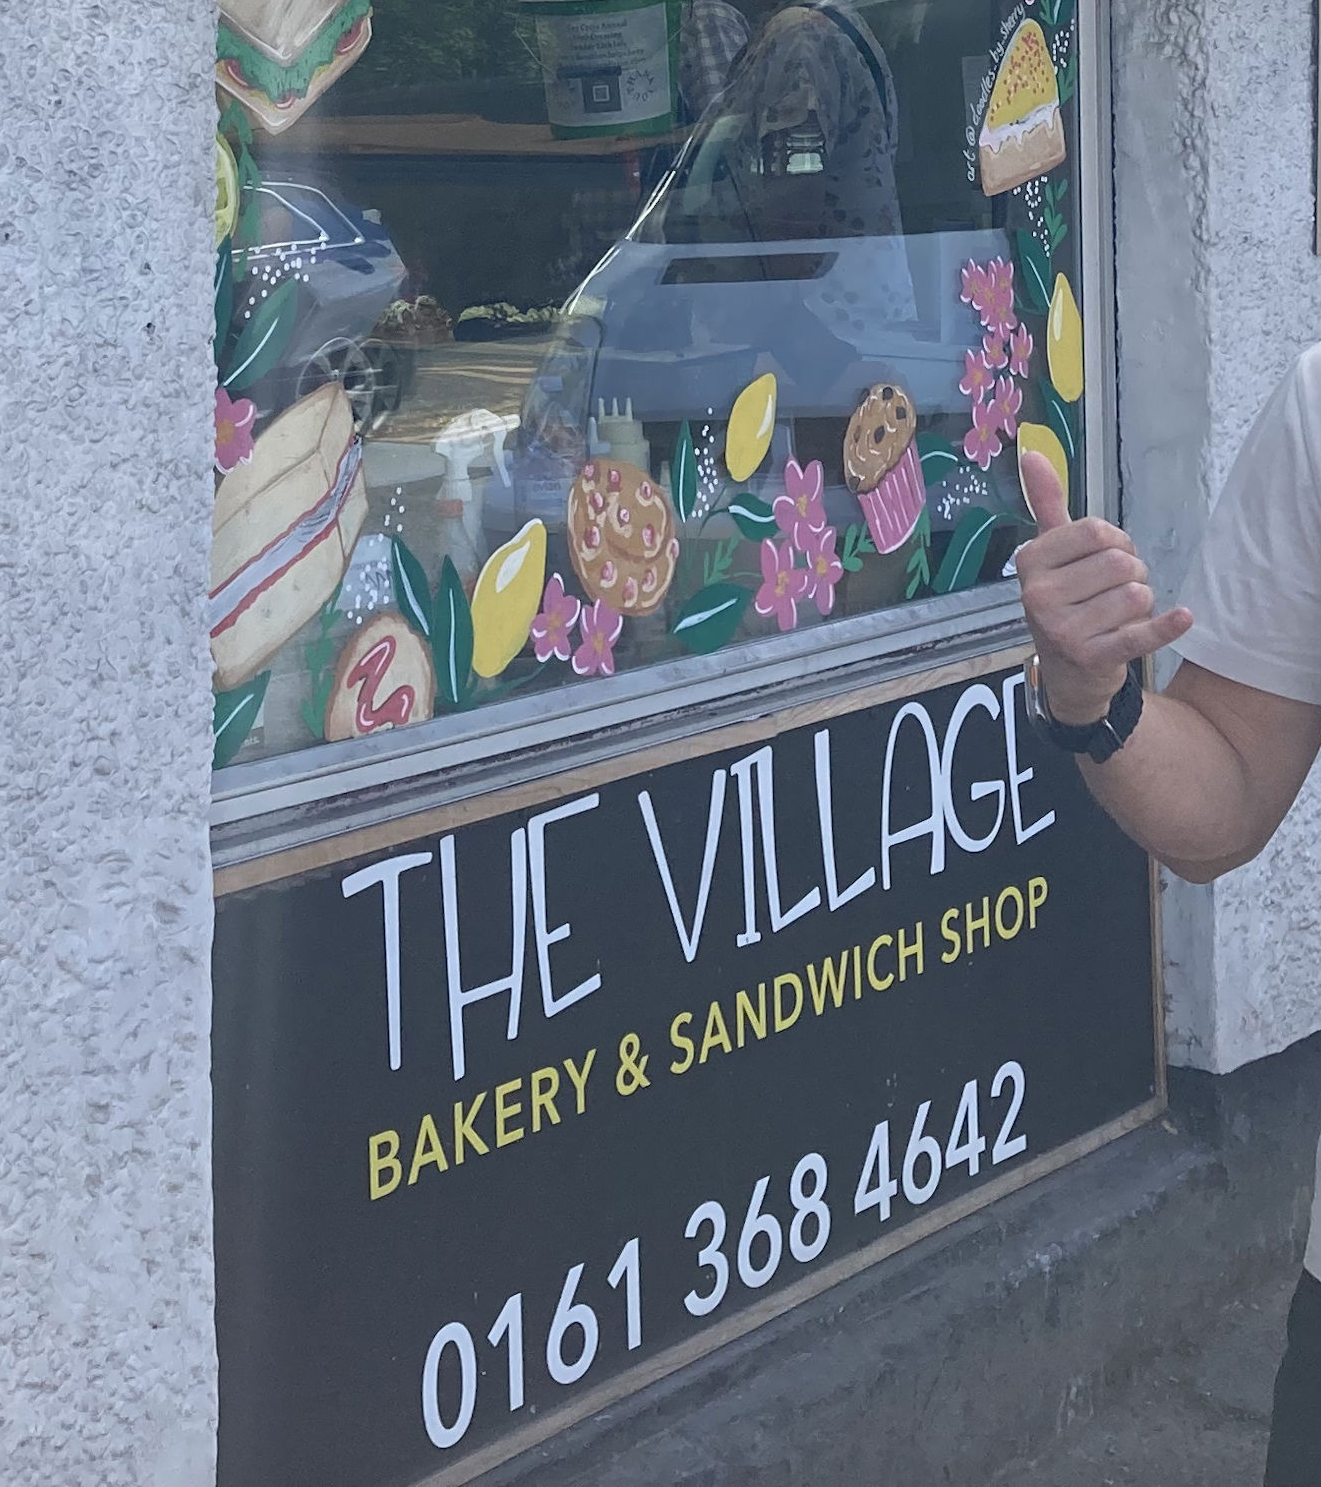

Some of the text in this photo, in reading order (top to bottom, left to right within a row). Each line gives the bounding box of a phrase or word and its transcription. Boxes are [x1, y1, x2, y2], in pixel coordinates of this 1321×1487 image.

[962, 149, 976, 181] art
[965, 125, 976, 147] @
[340, 670, 1056, 1082] THE VILLAGE
[367, 876, 1050, 1202] BAKERY & SANDWICH SHOP
[420, 1059, 1029, 1451] 0161 368 4642
